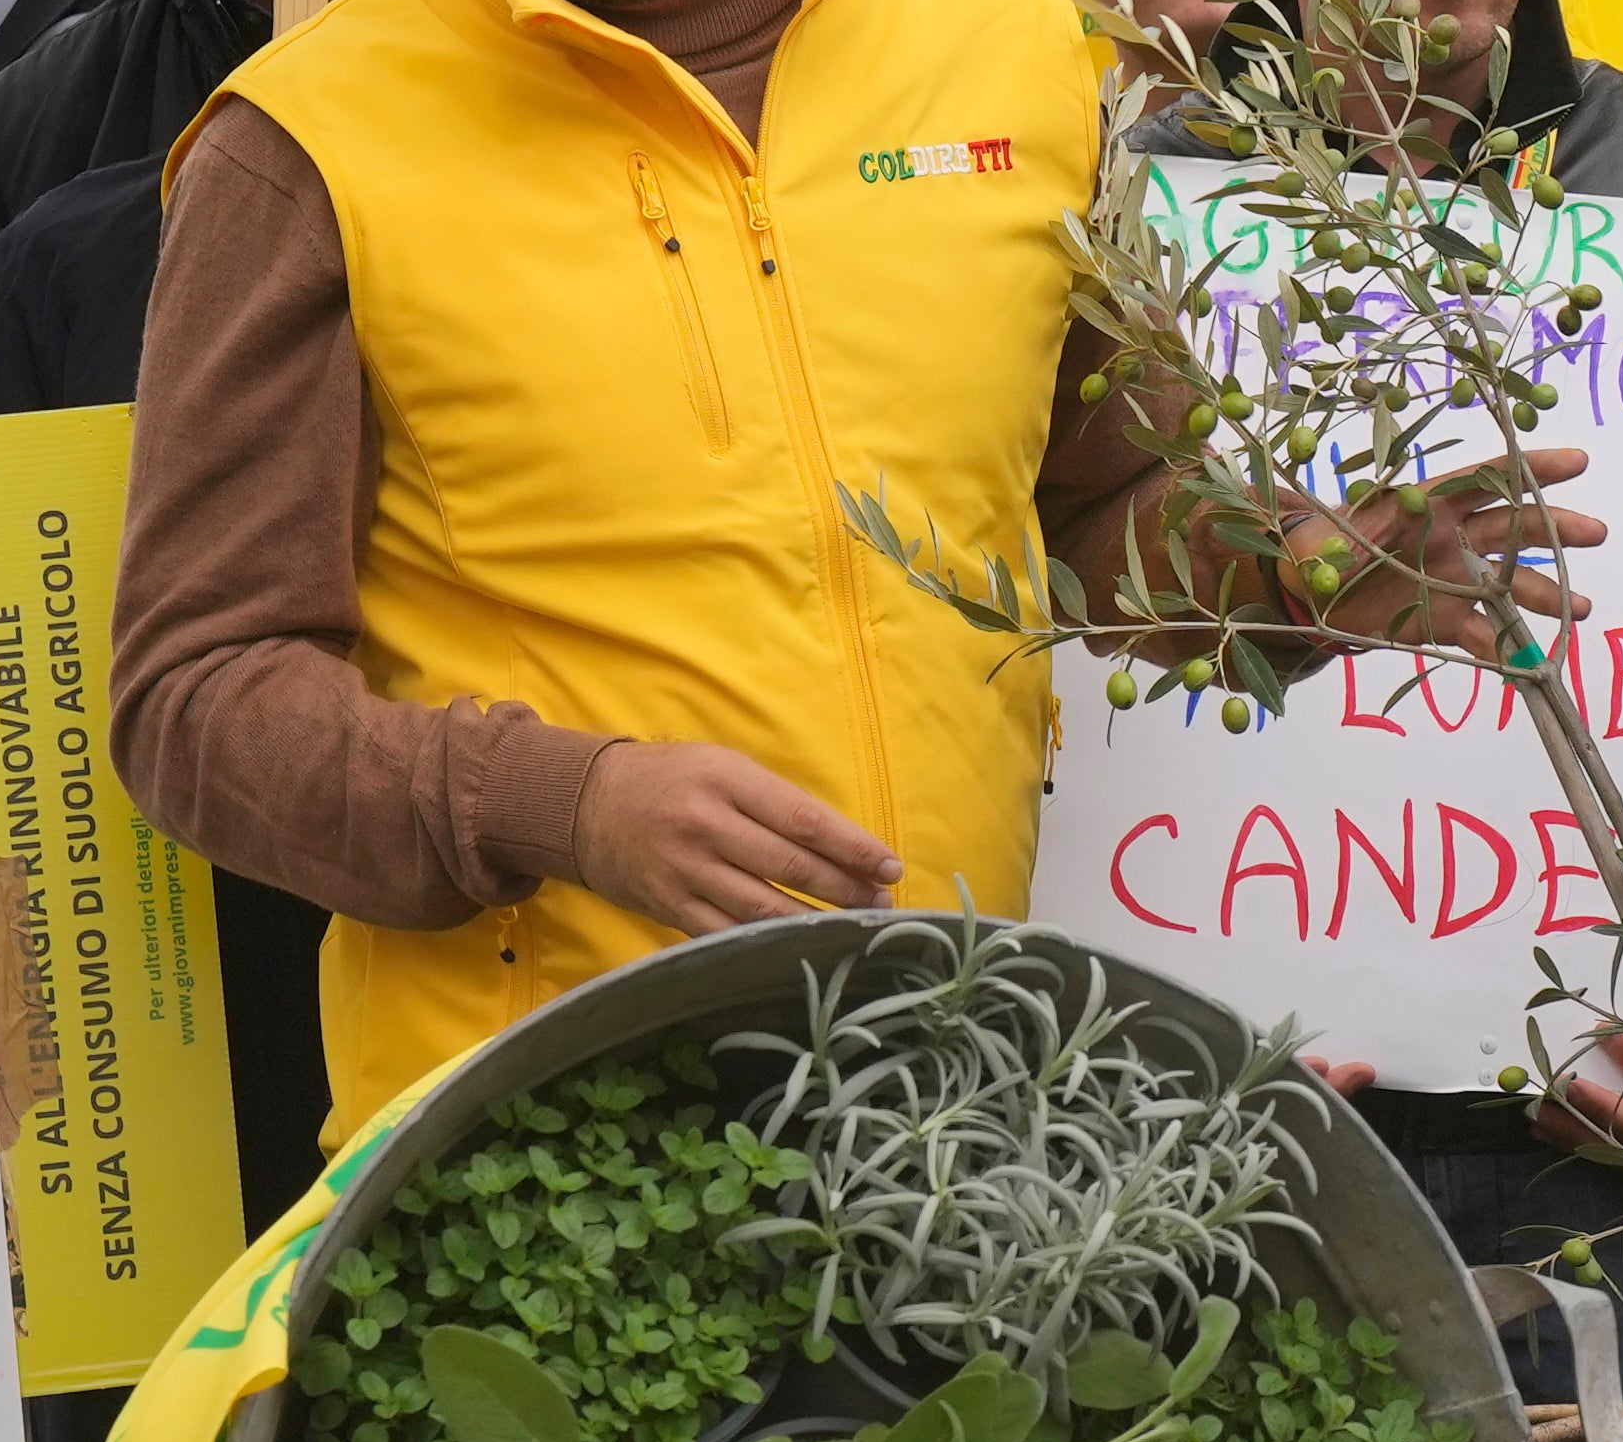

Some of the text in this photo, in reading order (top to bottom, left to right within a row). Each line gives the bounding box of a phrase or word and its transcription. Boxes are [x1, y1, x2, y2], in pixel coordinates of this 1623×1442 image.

[858, 138, 1013, 183] COLDIRETTI
[37, 507, 138, 1283] SENZA CONSUMO DI SUOLO AGRICOLO
[130, 814, 164, 1021] Per ulteriori dettagli
[40, 1167, 73, 1196] SI
